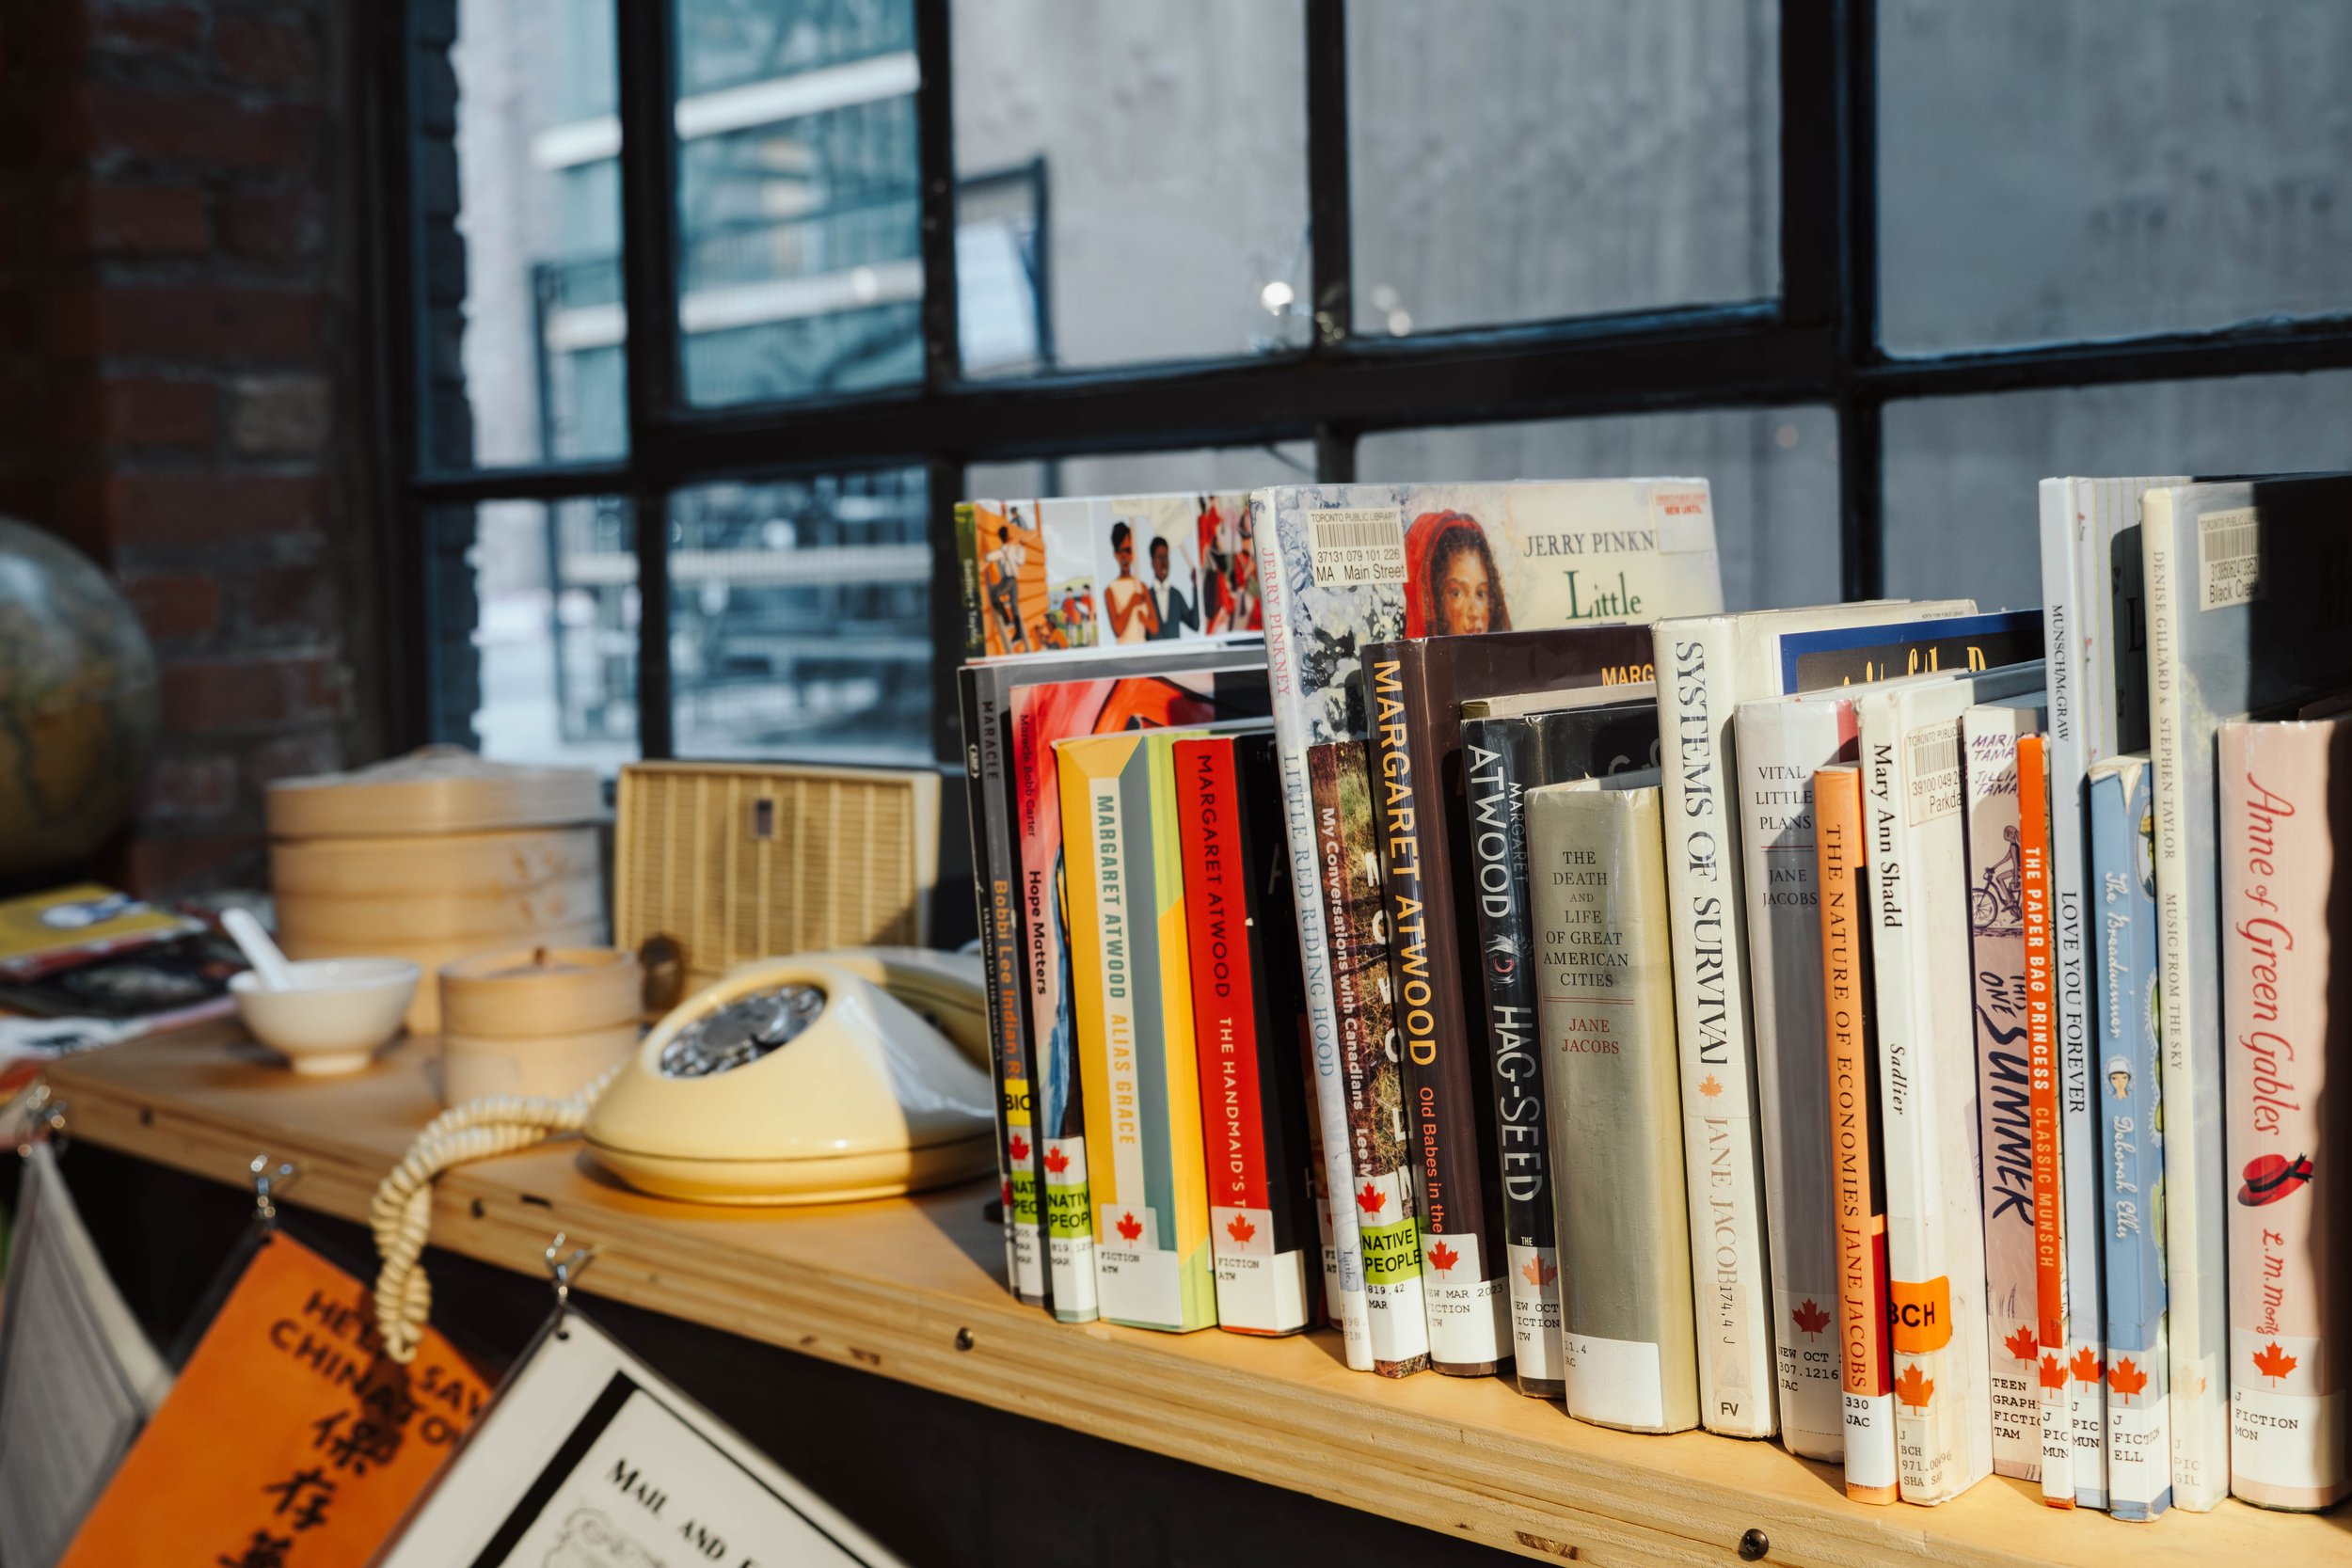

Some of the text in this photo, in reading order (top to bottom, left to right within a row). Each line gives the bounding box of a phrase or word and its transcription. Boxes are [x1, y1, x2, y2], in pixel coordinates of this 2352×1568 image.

[1311, 512, 1397, 523] TORONTO PUBLIC LIBRARY
[1523, 530, 1655, 557] JERRY PINKN
[1317, 548, 1400, 562] 37131 079 101 226
[1317, 563, 1406, 581] MA Main Street
[1564, 570, 1642, 620] Little
[2210, 581, 2233, 603] Black
[1262, 548, 1291, 696] JERRY PINKNEY
[1601, 664, 1655, 686] MARG
[2153, 551, 2175, 859] DENISE GILLARD STEPHEN TAYLOR
[1676, 641, 1714, 817] SYSTEMS
[982, 701, 999, 781] MARACLE
[1908, 731, 1935, 747] TORONTO
[1020, 715, 1036, 836] Maracle Carter
[1374, 660, 1421, 881] MARGARET
[1757, 767, 1806, 780] VITAL
[1912, 777, 1935, 796] 39100
[1756, 791, 1813, 805] LITTLE
[1468, 744, 1510, 918] ATWOOD
[1759, 816, 1812, 830] PLANS
[1508, 782, 1529, 883] MARGARET
[1870, 743, 1902, 928] Mary Ann Shadd
[1563, 851, 1597, 864] THE
[1687, 831, 1718, 882] OF
[1197, 754, 1231, 998] MARGARET ATWOOD
[1552, 872, 1608, 886] DEATH
[1769, 869, 1806, 885] JANE
[1097, 796, 1125, 998] MARGARET ATWOOD
[1569, 893, 1595, 903] AND
[1763, 892, 1818, 907] JACOBS
[993, 880, 1012, 940] Bobbi
[1284, 754, 1334, 1077] LITTLE RED RIDING HOOD
[1565, 910, 1602, 924] LIFE
[1029, 871, 1046, 995] Hope Matters
[1546, 931, 1623, 945] OF GREAT
[1543, 952, 1629, 967] AMERICAN
[2235, 771, 2300, 1136] Anne of Green Gables
[998, 945, 1014, 985] Lee
[2026, 847, 2049, 1090] THE PAPER BAG PRINCESS
[1322, 808, 1369, 1160] My Conversations with Canadians Lee
[1395, 895, 1437, 1066] ATWOOD
[1560, 973, 1613, 988] CITIES
[2166, 895, 2183, 1070] MUSIC FROM THE SKY
[1979, 972, 2017, 1019] ONE
[2061, 892, 2085, 1114] LOVE YOU FOREVER
[1001, 990, 1019, 1054] Indian
[1569, 1018, 1610, 1033] JANE
[1562, 1038, 1619, 1054] JACOBS
[1111, 1014, 1136, 1145] ALIAS GRACE
[1889, 1044, 1908, 1115] Sadlier
[1219, 1018, 1246, 1193] THE HANDMAID'S
[1493, 1006, 1543, 1202] HAG-SEED
[1826, 825, 1867, 1388] THE NATURE OF ECONOMIES JANE JACOBS
[1976, 1004, 2035, 1227] SUMMER
[1420, 1087, 1445, 1233] Old Babes in the
[1705, 1117, 1732, 1187] JANE
[2114, 1116, 2140, 1239] Deborah Ellis
[2035, 1108, 2054, 1267] CLASSIC MUNSCH
[1362, 1229, 1414, 1251] NATIVE
[1520, 1236, 1533, 1246] THE
[1101, 1252, 1140, 1262] FICTION
[1217, 1258, 1259, 1269] FICTION
[1364, 1249, 1421, 1273] PEOPLE
[1218, 1271, 1236, 1280] ATW
[1446, 1284, 1503, 1299] MAR 2023
[1368, 1299, 1389, 1310] MAR
[1535, 1304, 1560, 1313] OCT
[1720, 1286, 1735, 1327] 174.4
[304, 1290, 388, 1360] HEL
[1778, 1346, 1829, 1363] NEW OCT
[1779, 1362, 1839, 1380] 307.1216
[1780, 1379, 1799, 1391] JAC
[1992, 1378, 2026, 1391] TEEN
[1846, 1397, 1869, 1410] 330
[2235, 1391, 2241, 1402] J
[1721, 1402, 1739, 1417] FV
[2072, 1402, 2078, 1412] J
[1846, 1415, 1870, 1428] JAC
[2043, 1412, 2051, 1421] J
[2073, 1418, 2099, 1431] PIC
[2113, 1416, 2122, 1425] J
[2235, 1408, 2298, 1430] FICTION
[1994, 1427, 2020, 1439] TAM
[2043, 1429, 2069, 1441] PIC
[2114, 1427, 2160, 1445] FICTION
[2235, 1424, 2258, 1441] MON
[1901, 1445, 1922, 1456] BCH
[2073, 1436, 2100, 1449] MUN
[2043, 1446, 2069, 1458] MUN
[2114, 1450, 2143, 1463] ELL
[1902, 1451, 1952, 1473] 971.00496
[1904, 1476, 1924, 1487] SHA
[609, 1458, 726, 1561] MAIL AND
